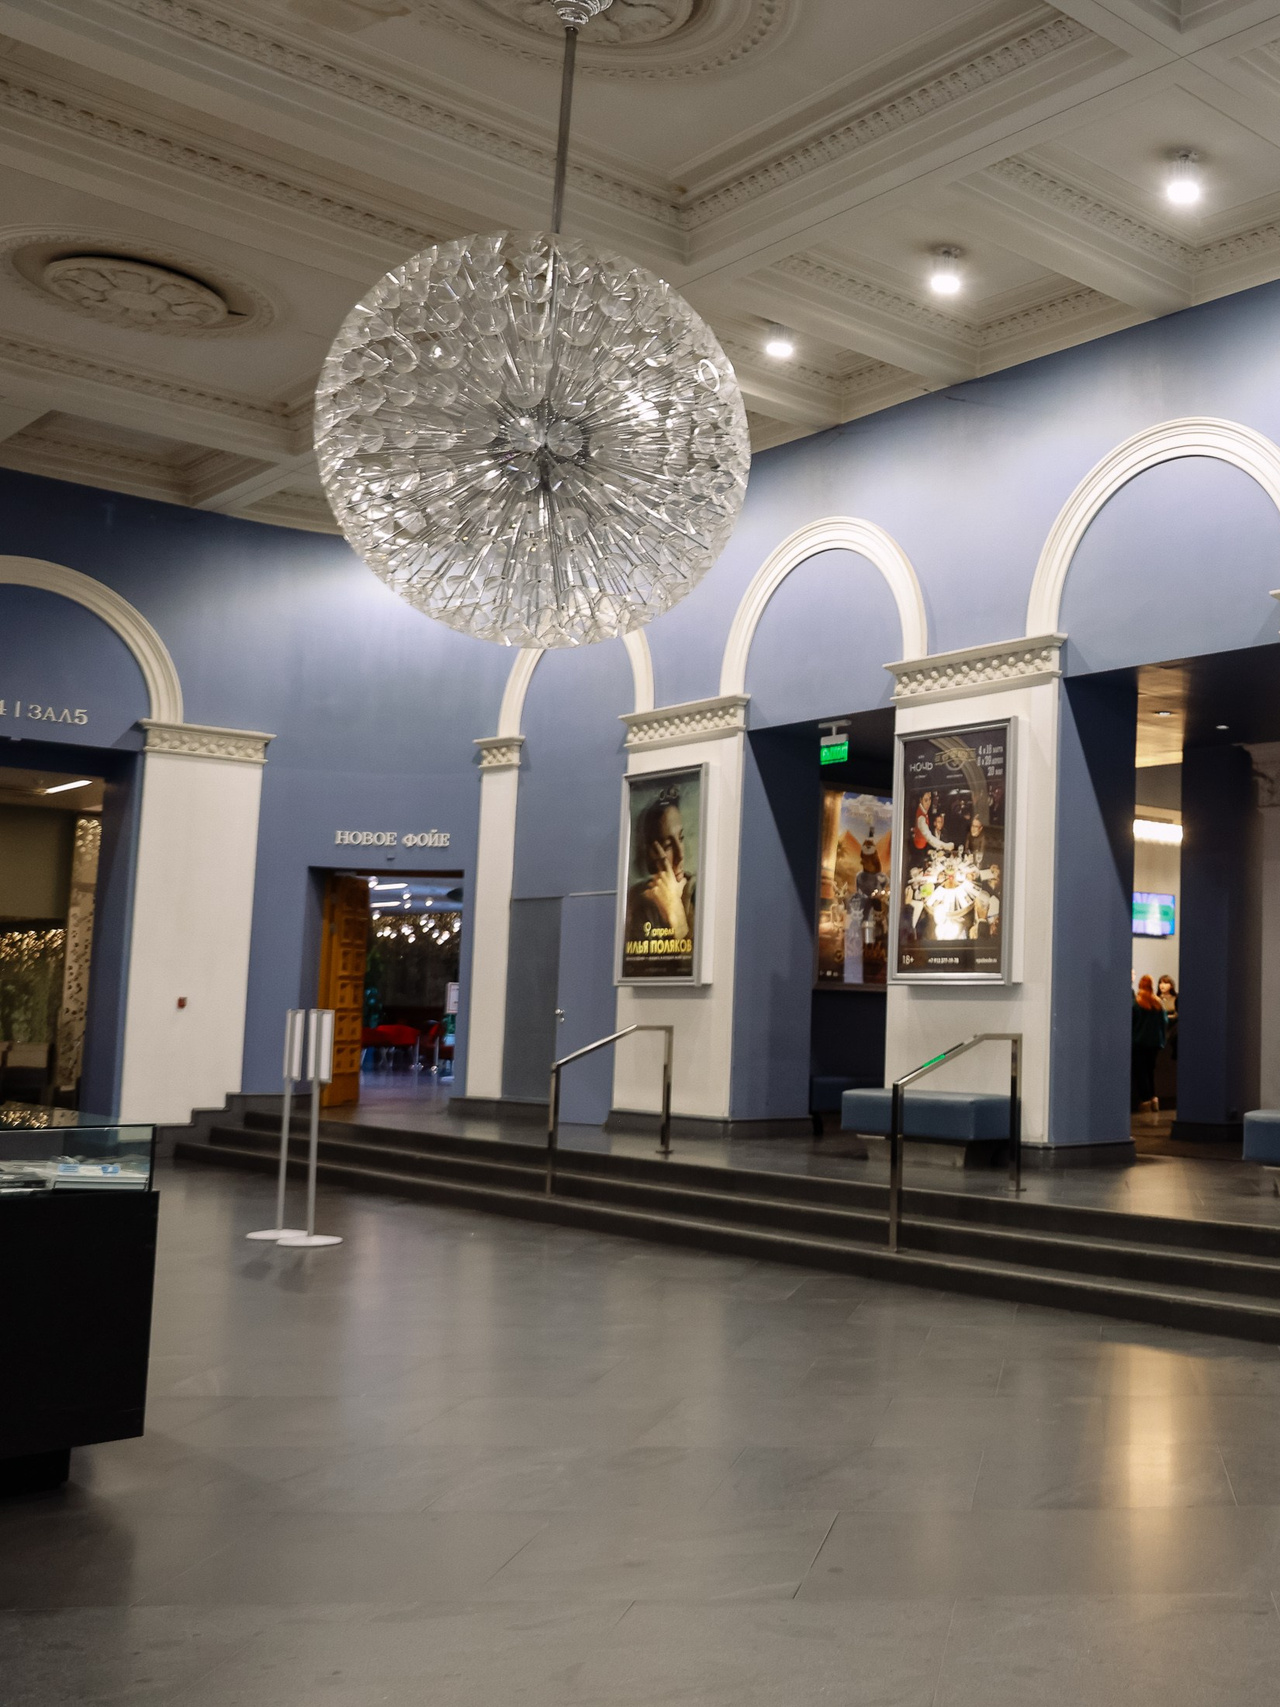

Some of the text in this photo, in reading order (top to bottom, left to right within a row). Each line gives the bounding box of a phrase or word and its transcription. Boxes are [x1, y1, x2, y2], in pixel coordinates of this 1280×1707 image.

[335, 829, 450, 848] НОВОЕ ФОЙЕ
[643, 921, 652, 937] 9
[626, 939, 692, 955] ИЛЬЯ ПОЛЯКОВ
[902, 955, 914, 965] 18+
